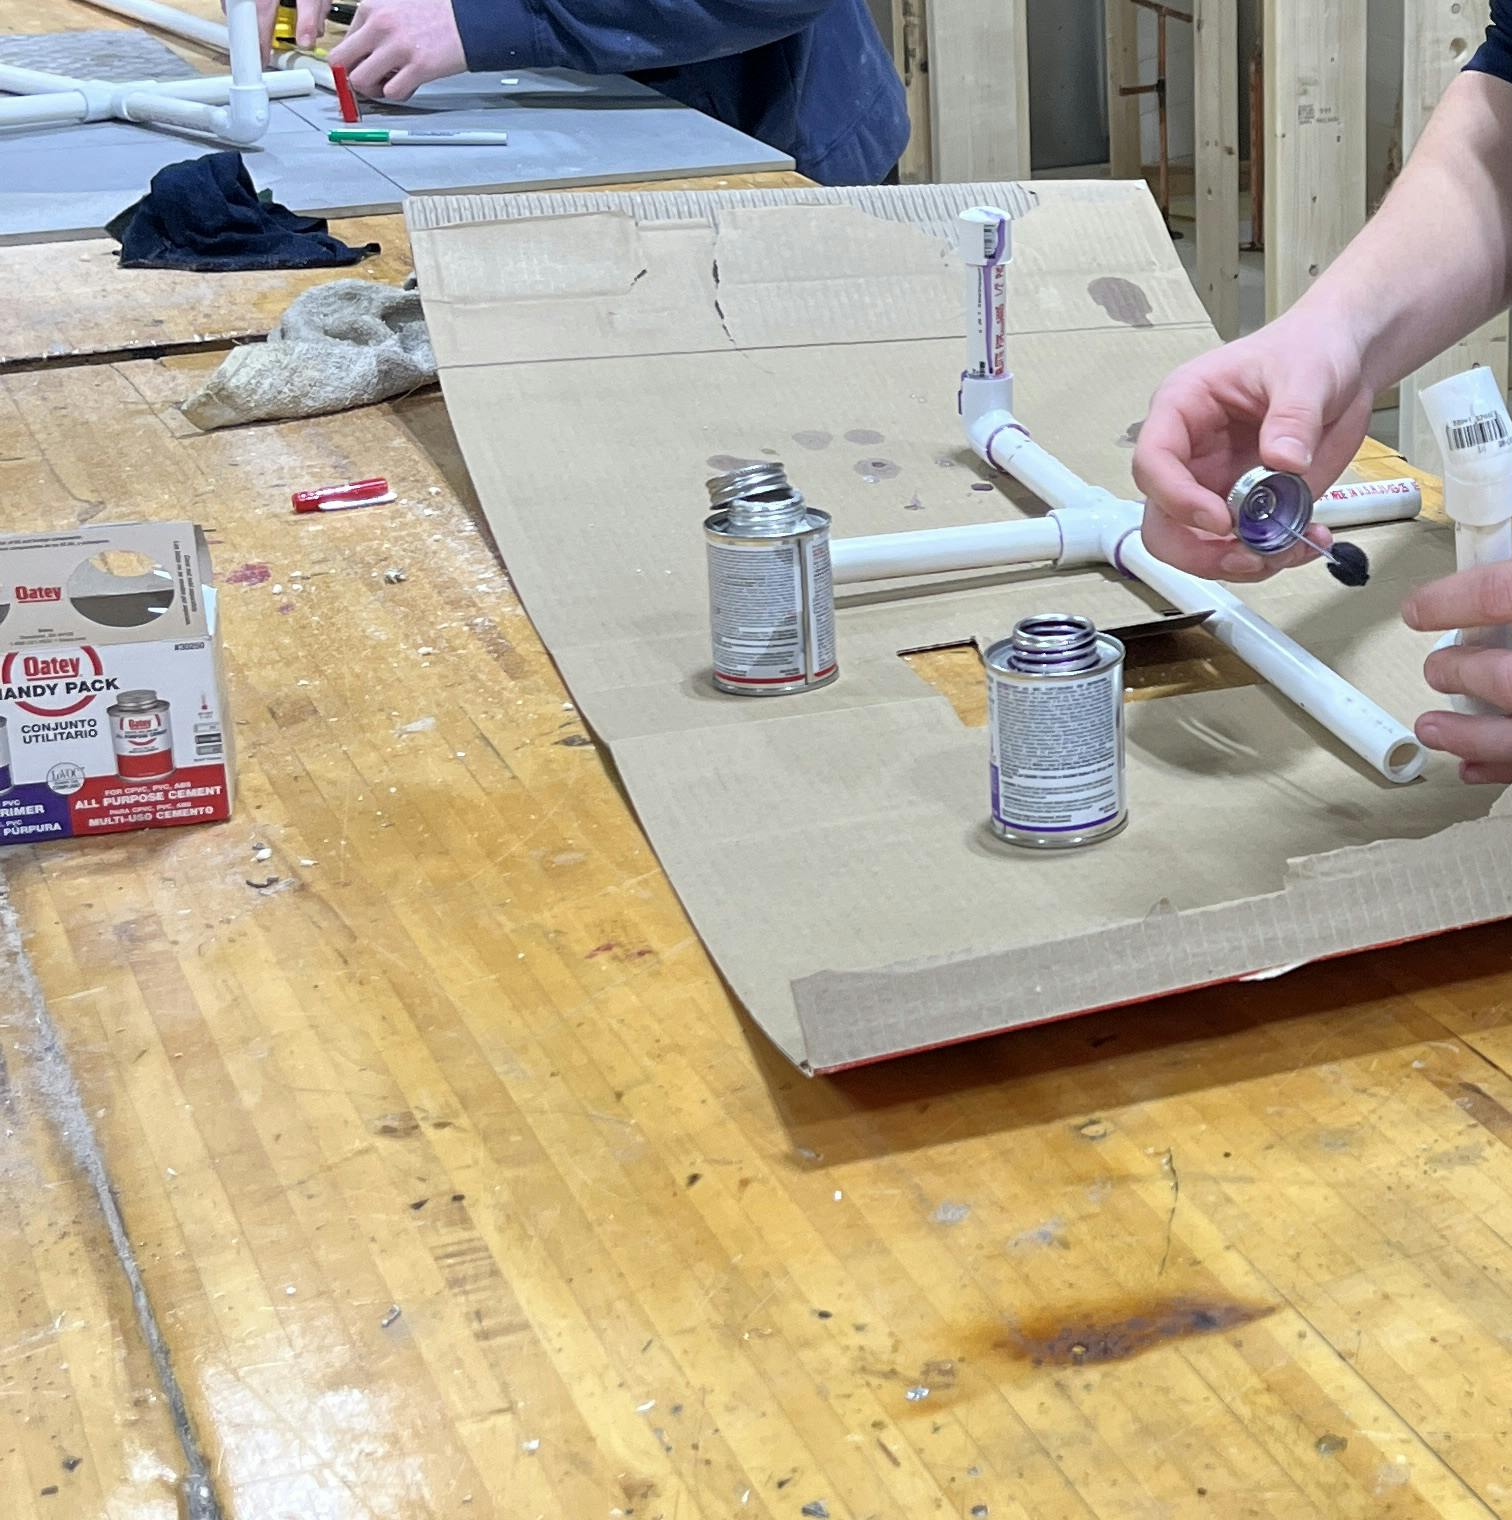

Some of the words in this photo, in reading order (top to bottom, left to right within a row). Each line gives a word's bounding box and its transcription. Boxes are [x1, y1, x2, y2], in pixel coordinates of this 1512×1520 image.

[15, 586, 62, 603] Oatey
[23, 656, 80, 677] Oatey
[65, 677, 120, 694] PACK
[21, 718, 97, 734] CONJUNTO
[23, 729, 98, 744] UTILITARIO
[75, 798, 100, 810] ALL
[103, 791, 164, 807] PURPOSE
[168, 785, 222, 799] CEMENT
[0, 804, 45, 817] RIMER
[88, 812, 152, 827] MULTI-USO
[156, 806, 214, 820] CEMENTO
